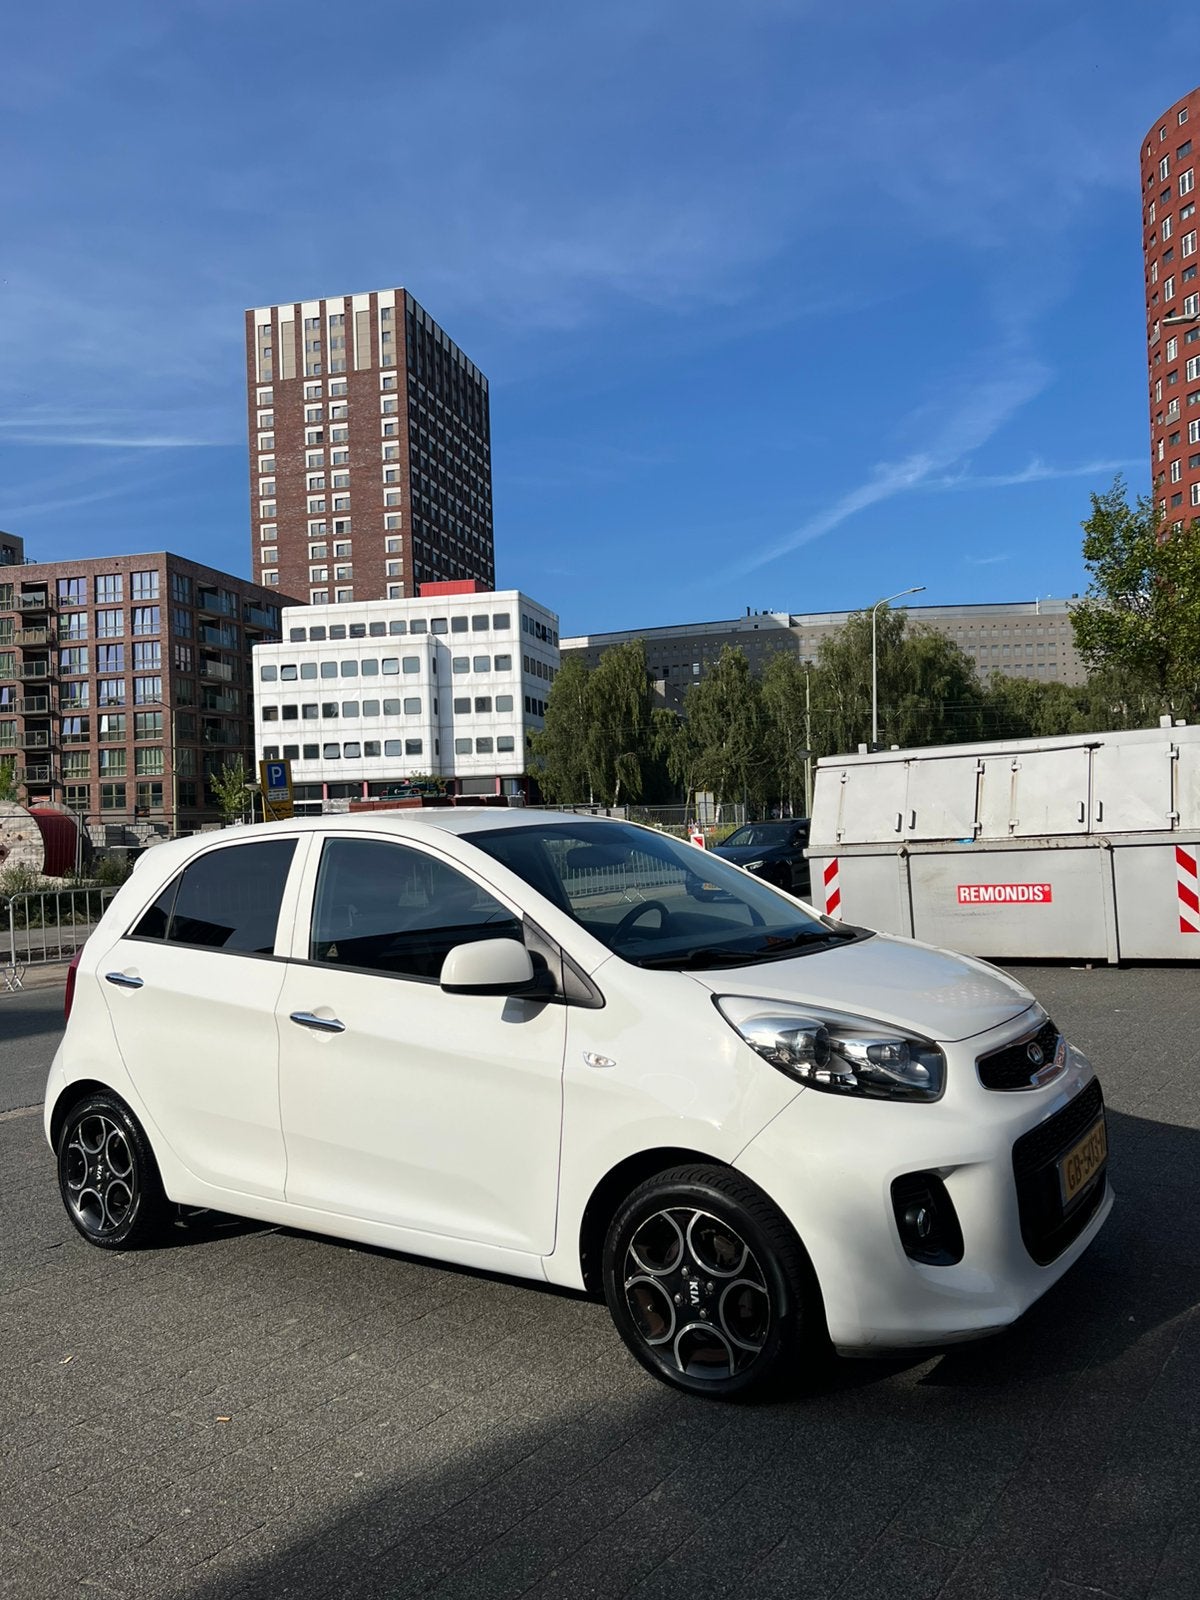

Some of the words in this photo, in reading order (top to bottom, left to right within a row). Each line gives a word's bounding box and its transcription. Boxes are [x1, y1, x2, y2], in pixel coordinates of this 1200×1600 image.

[271, 766, 282, 785] P
[959, 885, 1044, 902] REMONDIS
[689, 1281, 700, 1304] KIA
